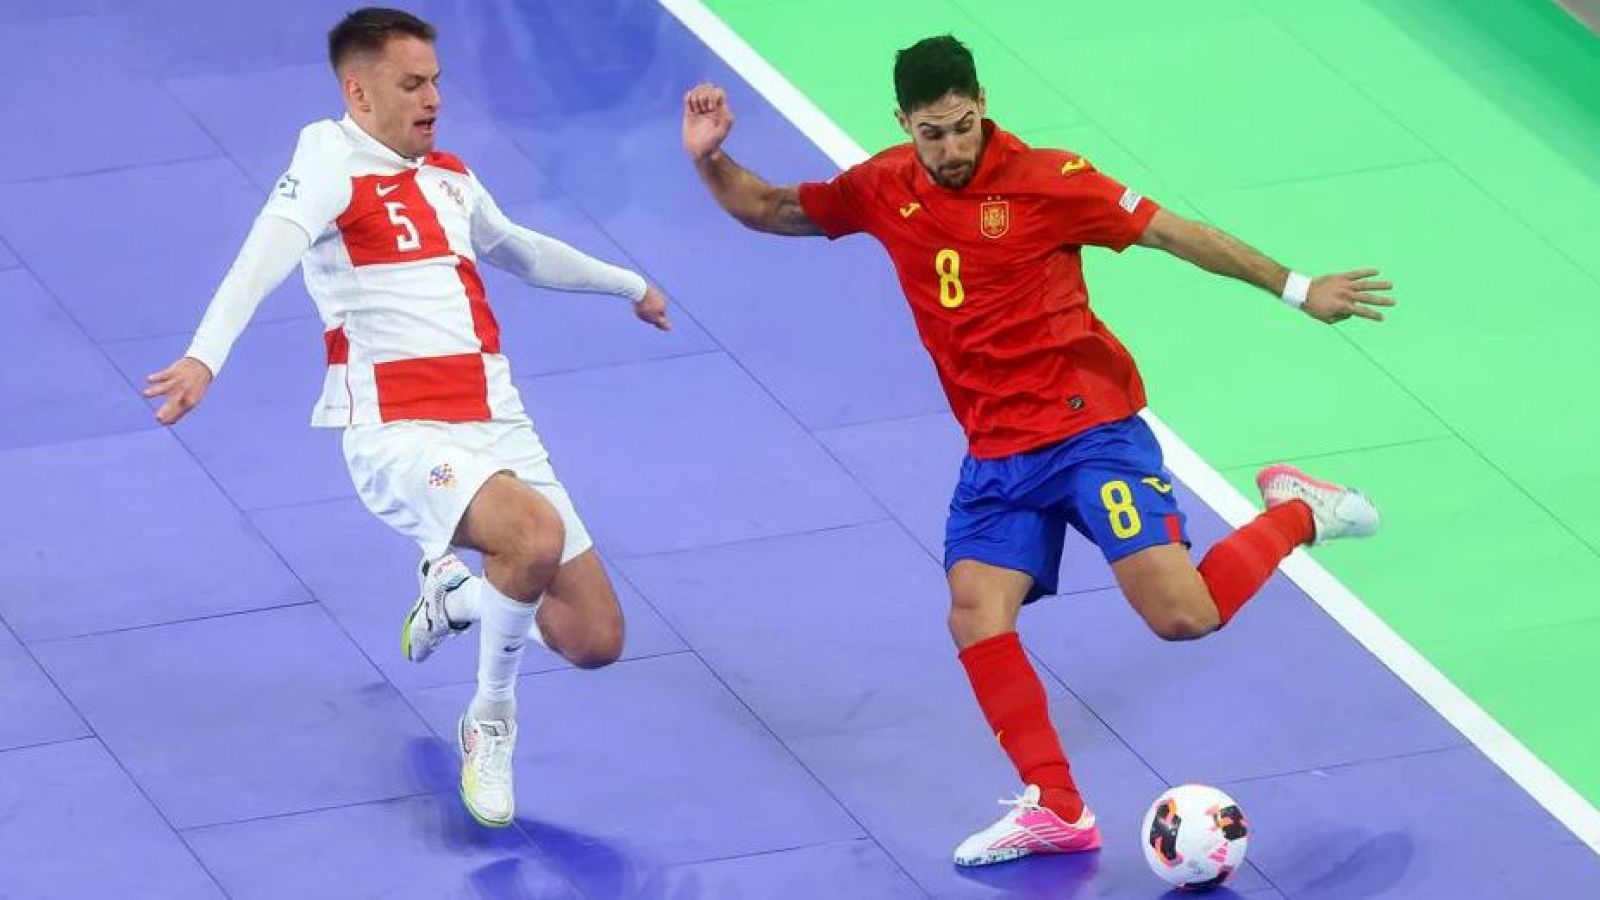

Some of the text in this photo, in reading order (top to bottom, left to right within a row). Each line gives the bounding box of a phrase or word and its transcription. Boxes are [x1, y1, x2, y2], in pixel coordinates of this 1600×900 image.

[385, 202, 421, 251] 5
[935, 249, 965, 308] 8
[1100, 480, 1142, 539] 8
